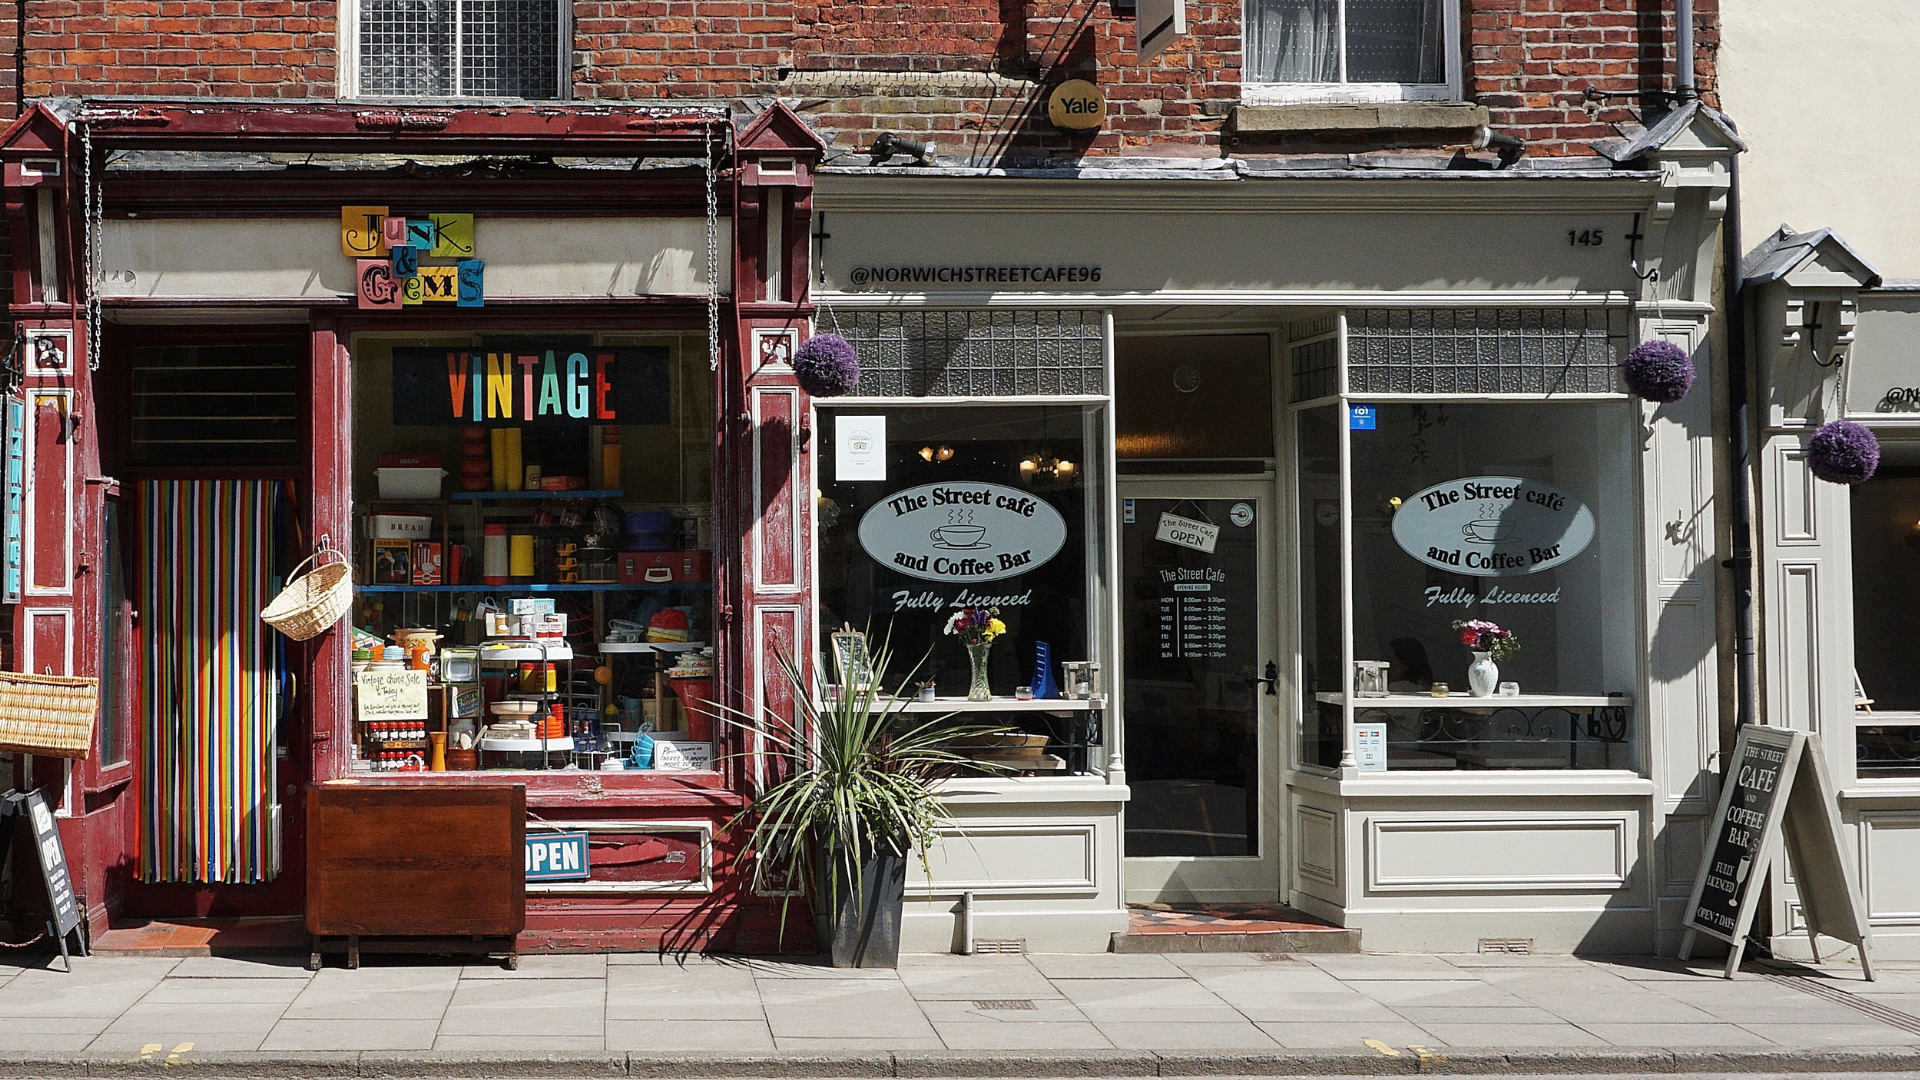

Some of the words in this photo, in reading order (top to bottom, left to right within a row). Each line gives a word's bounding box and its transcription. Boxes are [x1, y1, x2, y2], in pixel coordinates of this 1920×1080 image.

[1060, 97, 1099, 114] Yale
[1568, 230, 1603, 247] 145
[395, 246, 417, 276] &
[850, 267, 1101, 286] @NORWICHSTREETCAFE96
[446, 350, 617, 421] VINTAGE
[888, 494, 928, 517] The
[932, 487, 992, 506] Street
[995, 494, 1038, 517] café
[1421, 489, 1460, 512] The
[1463, 482, 1522, 501] Street
[1526, 489, 1566, 512] café
[390, 523, 424, 532] BREAD
[1162, 519, 1177, 527] The
[1179, 520, 1199, 531] Street
[1170, 529, 1205, 547] OPEN
[894, 551, 929, 571] and
[933, 557, 995, 576] Coffee
[997, 549, 1031, 571] Bar
[1427, 546, 1461, 566] and
[1465, 551, 1525, 570] Coffee
[1529, 543, 1561, 565] Bar
[1160, 569, 1177, 583] The
[1177, 567, 1204, 580] Street
[1205, 567, 1225, 583] Cafe
[891, 590, 945, 612] Fully
[950, 588, 1032, 608] Licenced
[1424, 586, 1476, 608] Fully
[1480, 585, 1561, 605] Licenced
[361, 674, 384, 691] Vintage
[405, 673, 421, 686] Sale
[1745, 746, 1760, 760] THE
[1759, 748, 1786, 764] STREET
[1739, 765, 1777, 793] CAFÉ
[1746, 795, 1757, 803] AND
[1727, 805, 1765, 830] COFFEE
[1728, 827, 1749, 848] BAR
[1715, 861, 1735, 877] FULLY
[1706, 875, 1735, 893] LICENCED
[1697, 907, 1714, 922] OPEN
[1719, 914, 1736, 930] DAYS
